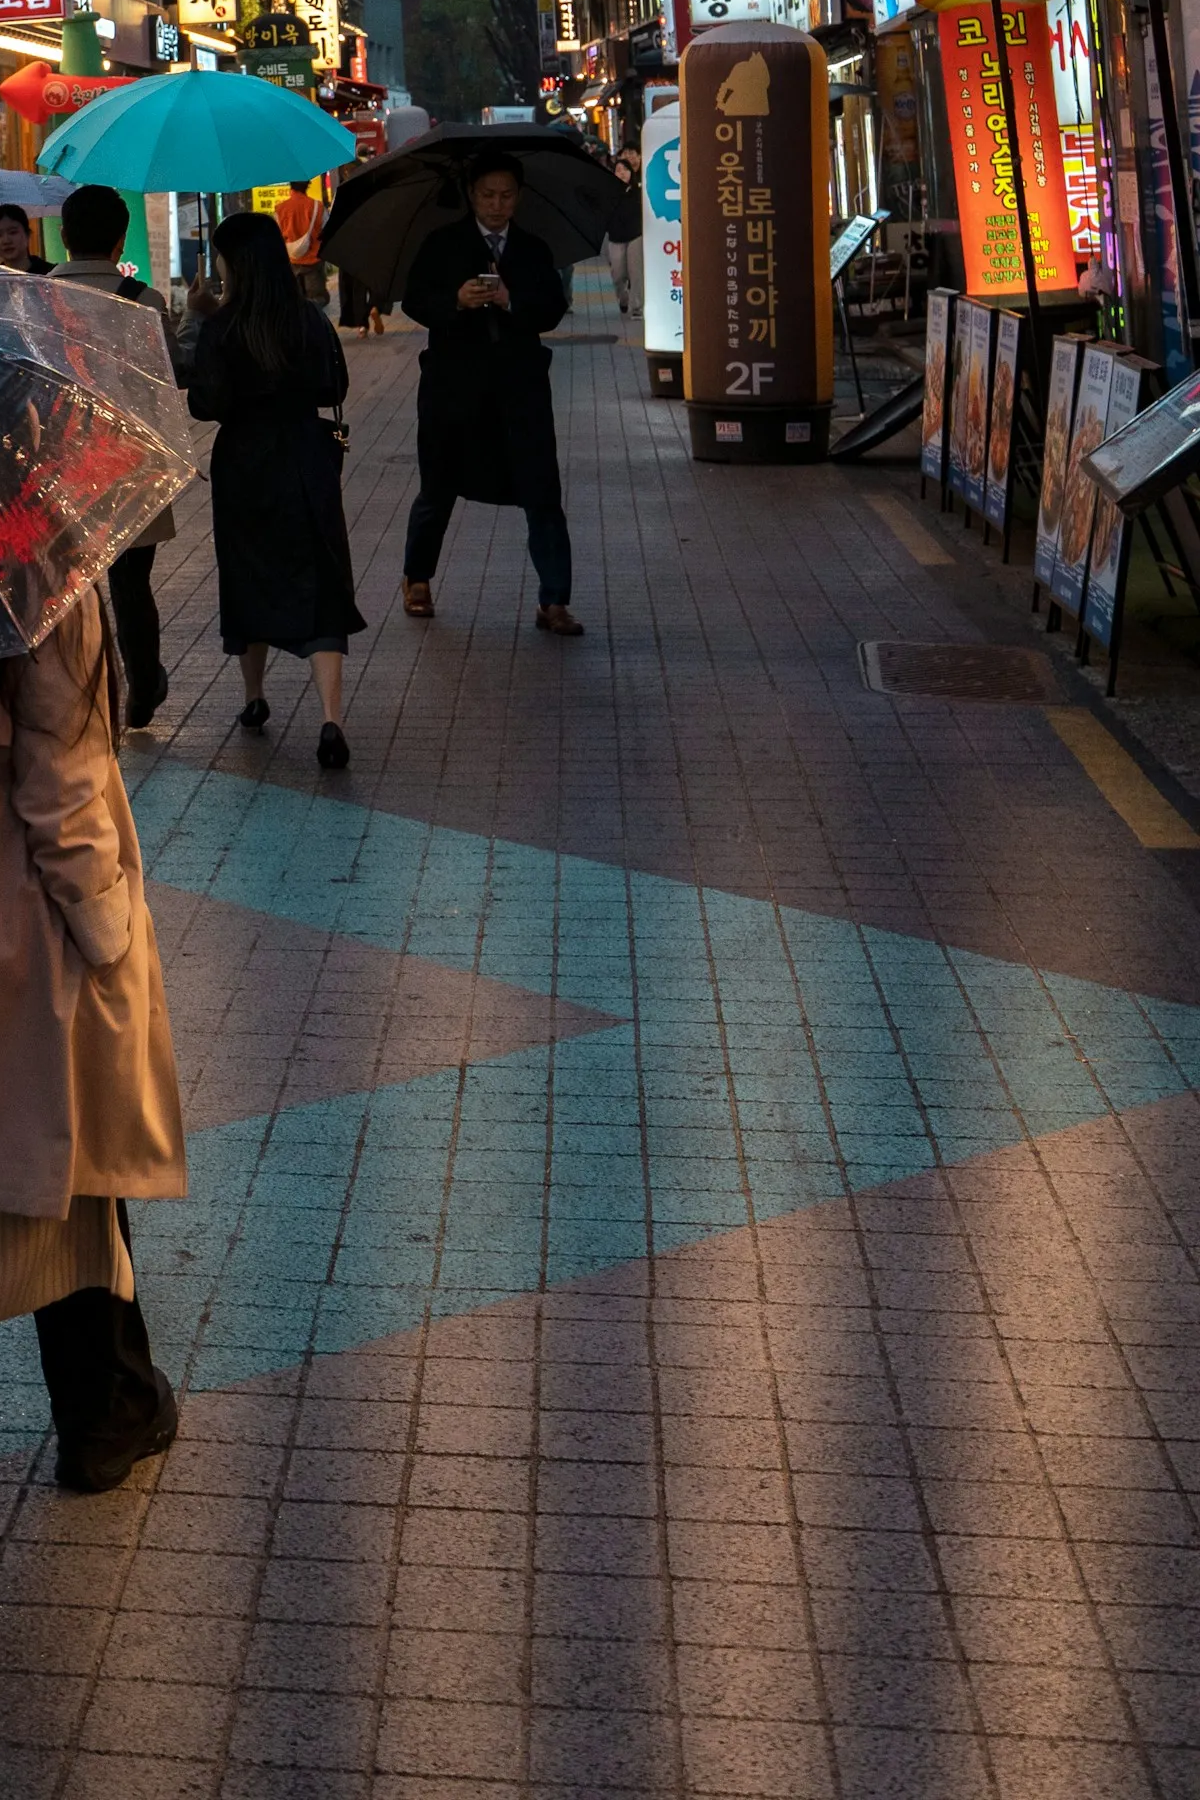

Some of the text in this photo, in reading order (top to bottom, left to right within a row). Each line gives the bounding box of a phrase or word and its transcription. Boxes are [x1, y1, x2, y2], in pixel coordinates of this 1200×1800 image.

[245, 23, 300, 48] 방이옥
[956, 11, 1028, 50] 코인
[256, 62, 289, 77] 수비드
[284, 74, 307, 87] 전문
[715, 120, 744, 218] 이웃집
[1020, 239, 1050, 252] 래방
[745, 187, 777, 349] 로바다야끼
[724, 361, 776, 397] 2F
